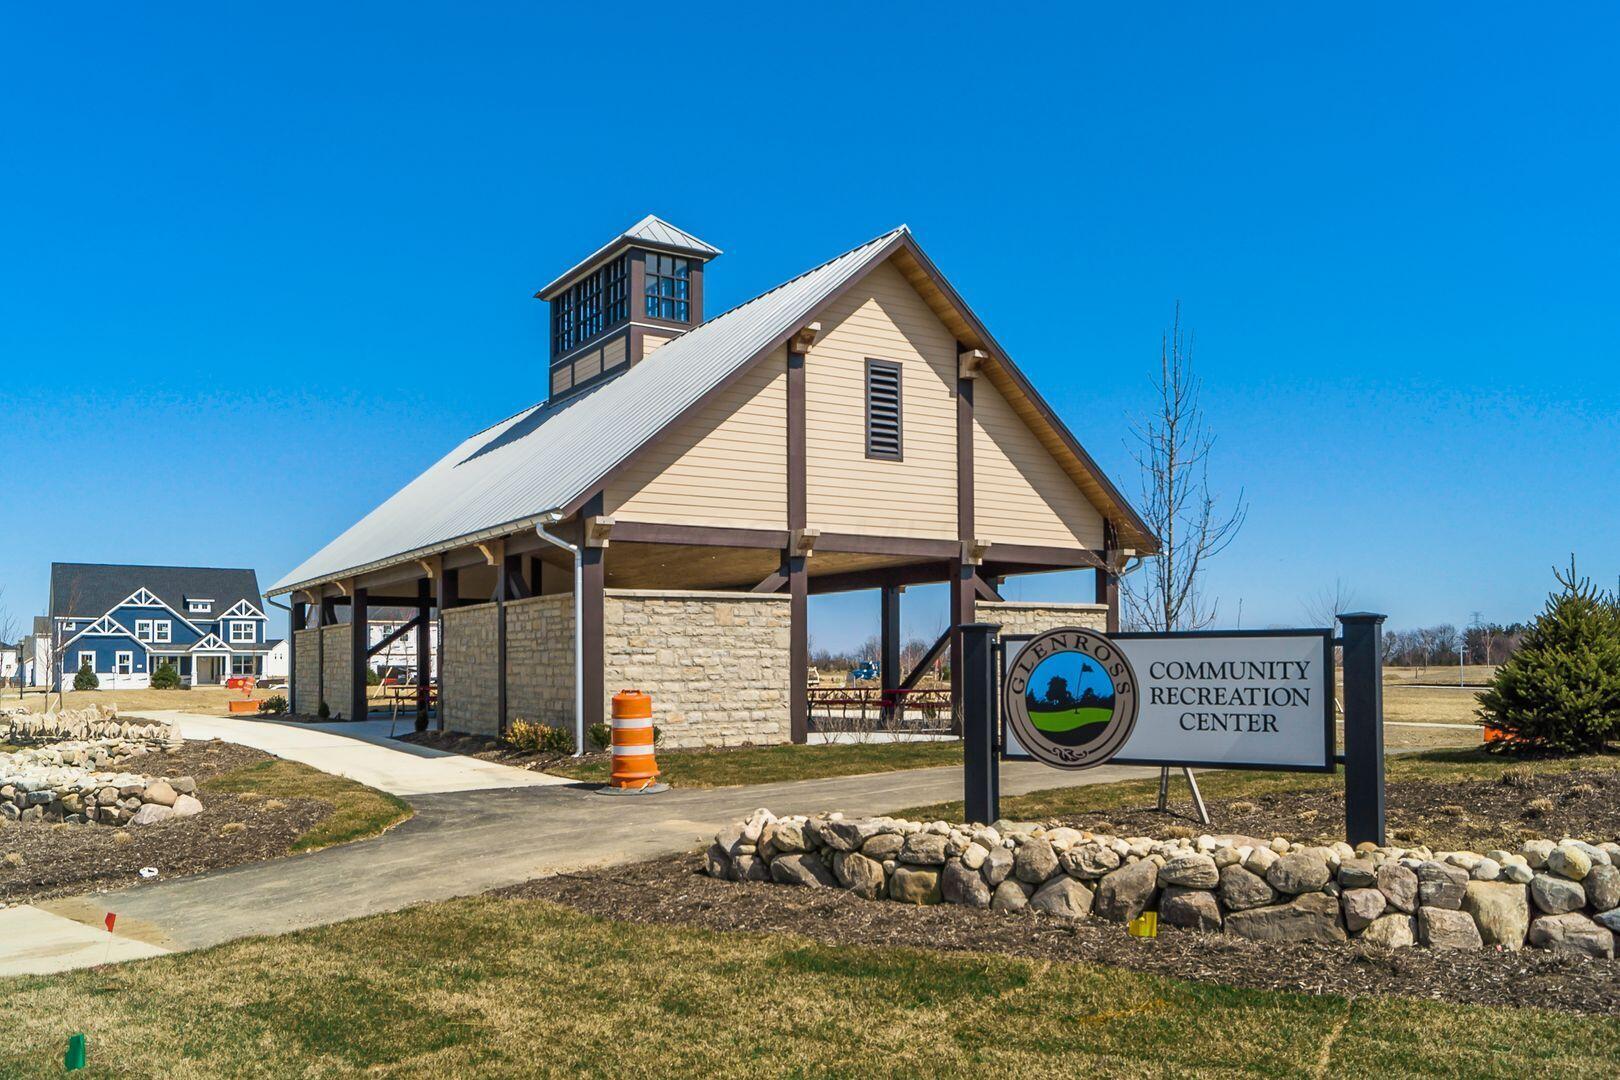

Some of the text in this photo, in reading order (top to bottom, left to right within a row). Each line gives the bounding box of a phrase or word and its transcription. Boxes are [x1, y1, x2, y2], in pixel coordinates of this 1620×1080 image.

[1011, 634, 1131, 695] GLENROSS
[1149, 660, 1311, 681] COMMUNITY
[1150, 686, 1311, 707] RECREATION
[1179, 712, 1280, 733] CENTER
